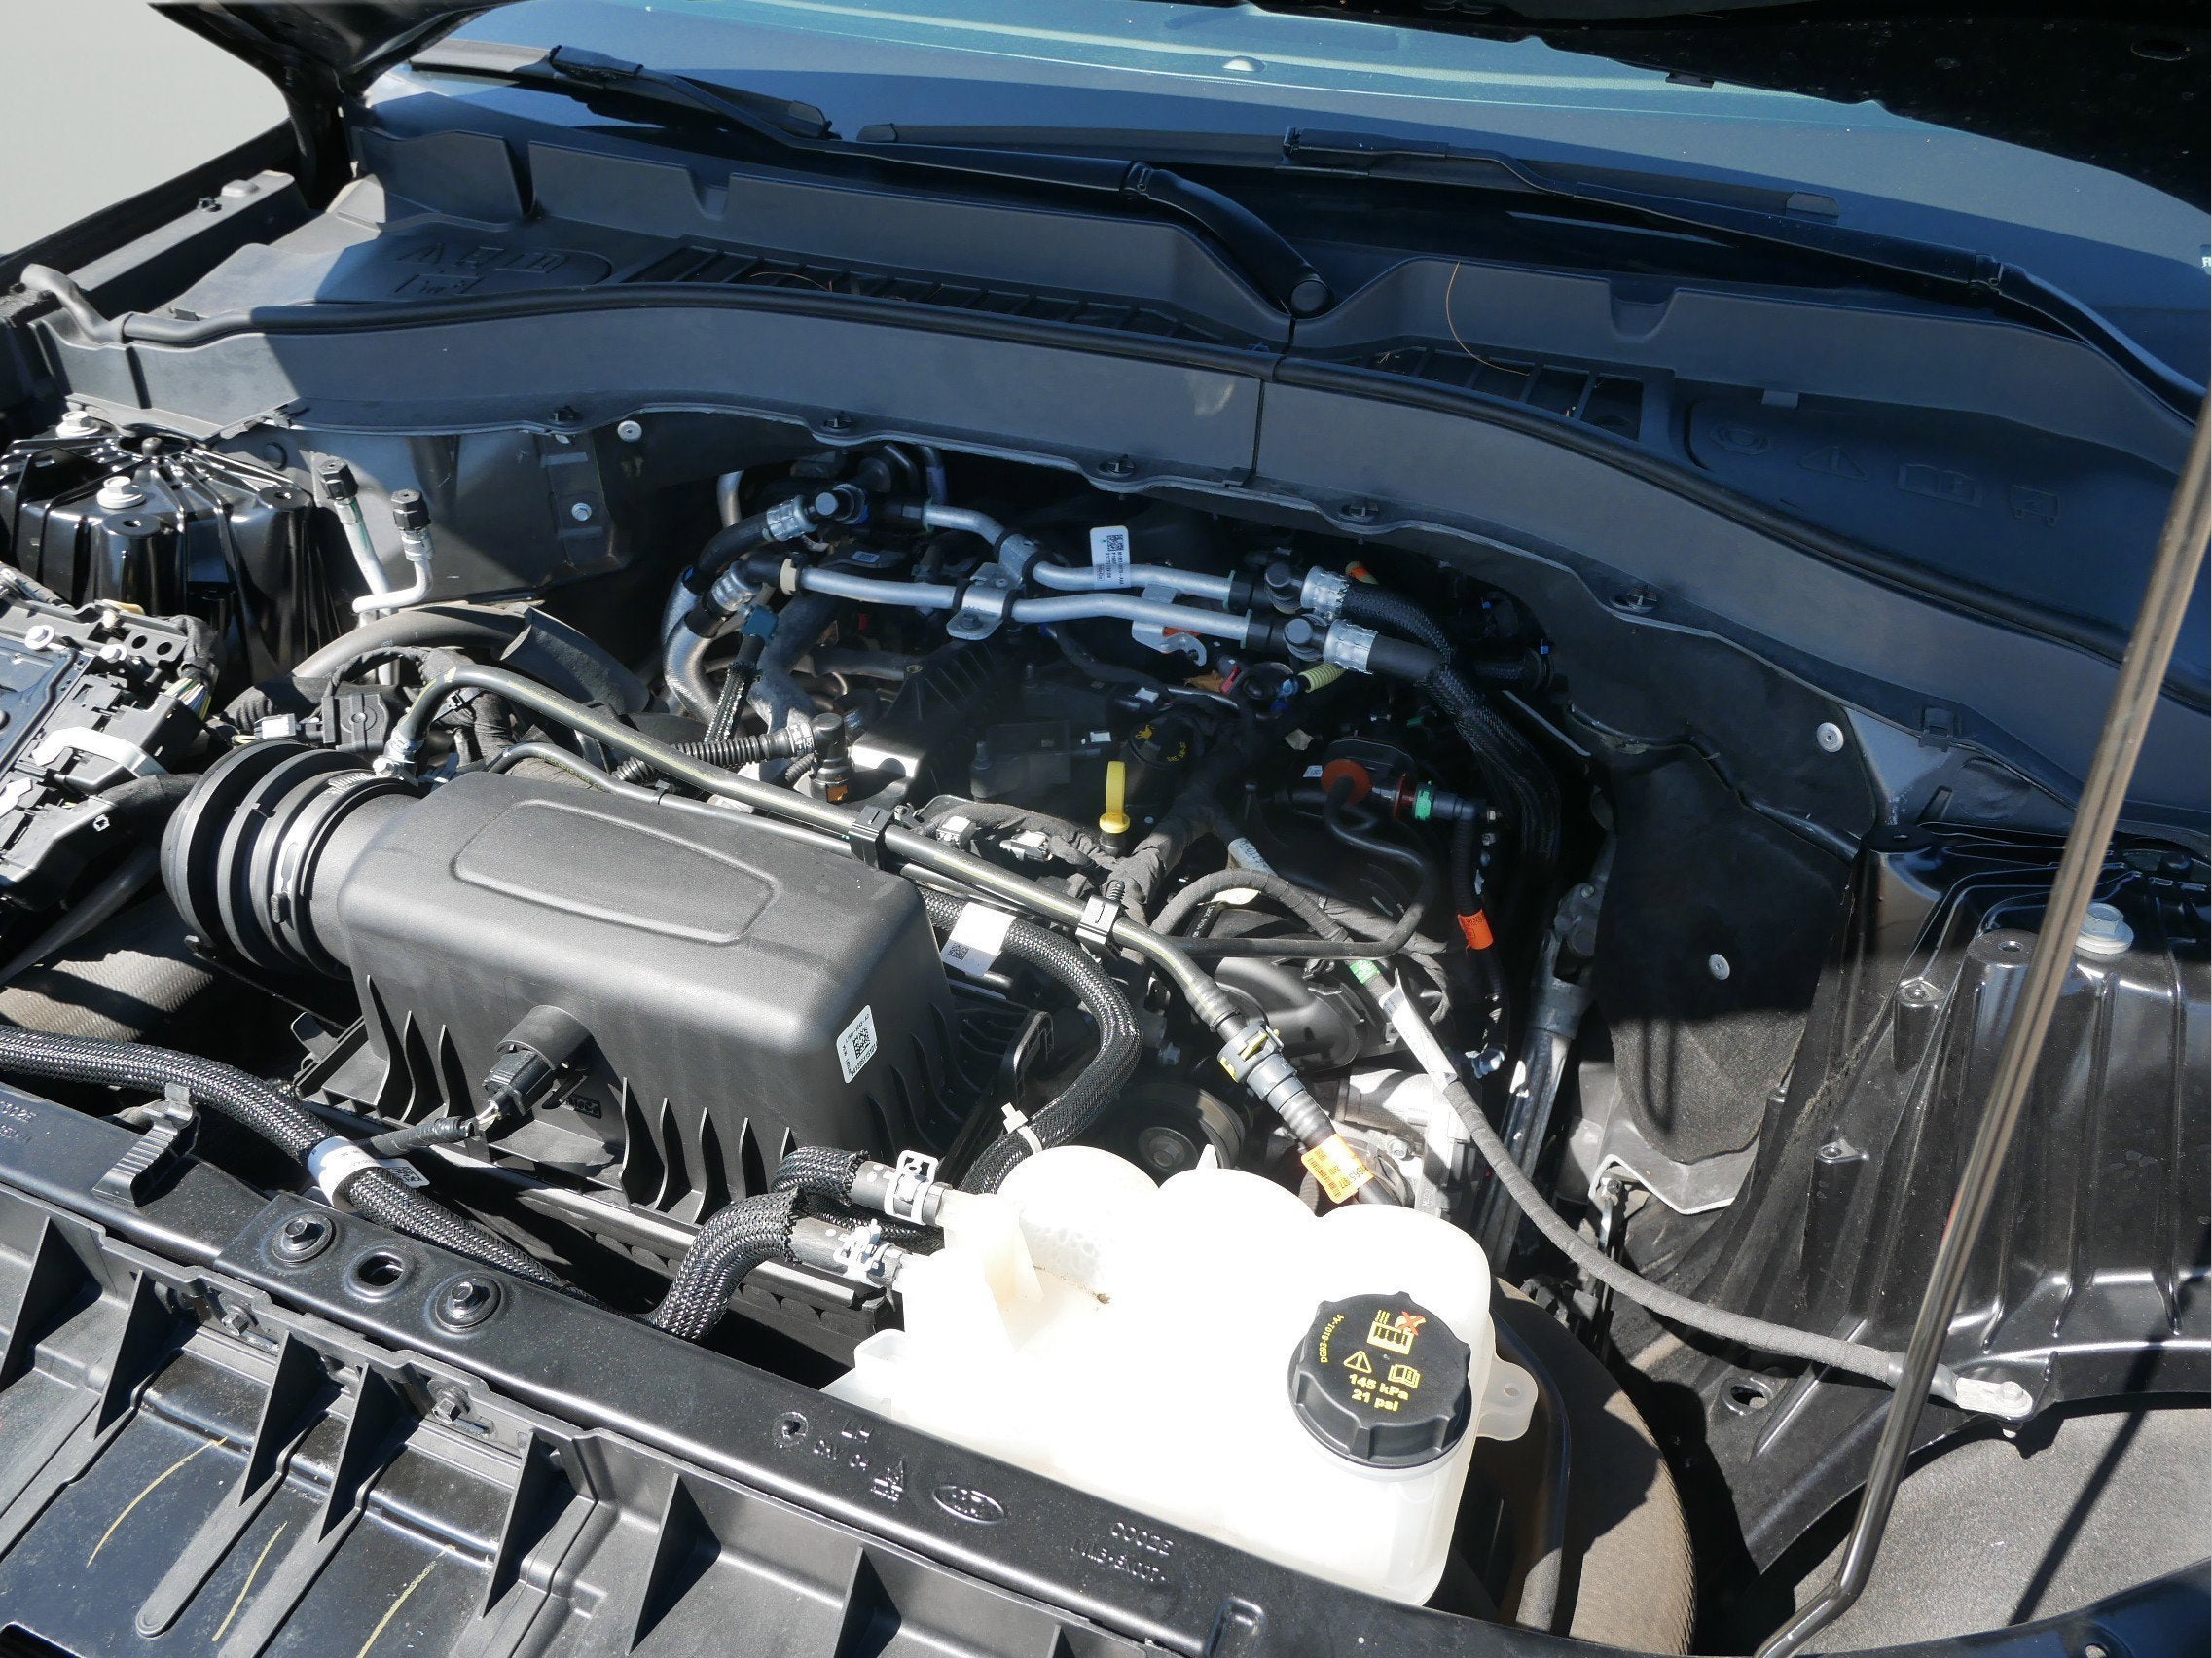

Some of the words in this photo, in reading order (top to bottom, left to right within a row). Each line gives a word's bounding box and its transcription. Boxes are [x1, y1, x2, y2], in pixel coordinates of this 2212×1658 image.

[1349, 1374, 1377, 1389] 145
[1379, 1383, 1409, 1401] kPa
[1351, 1388, 1371, 1403] 21
[1374, 1398, 1398, 1412] psi
